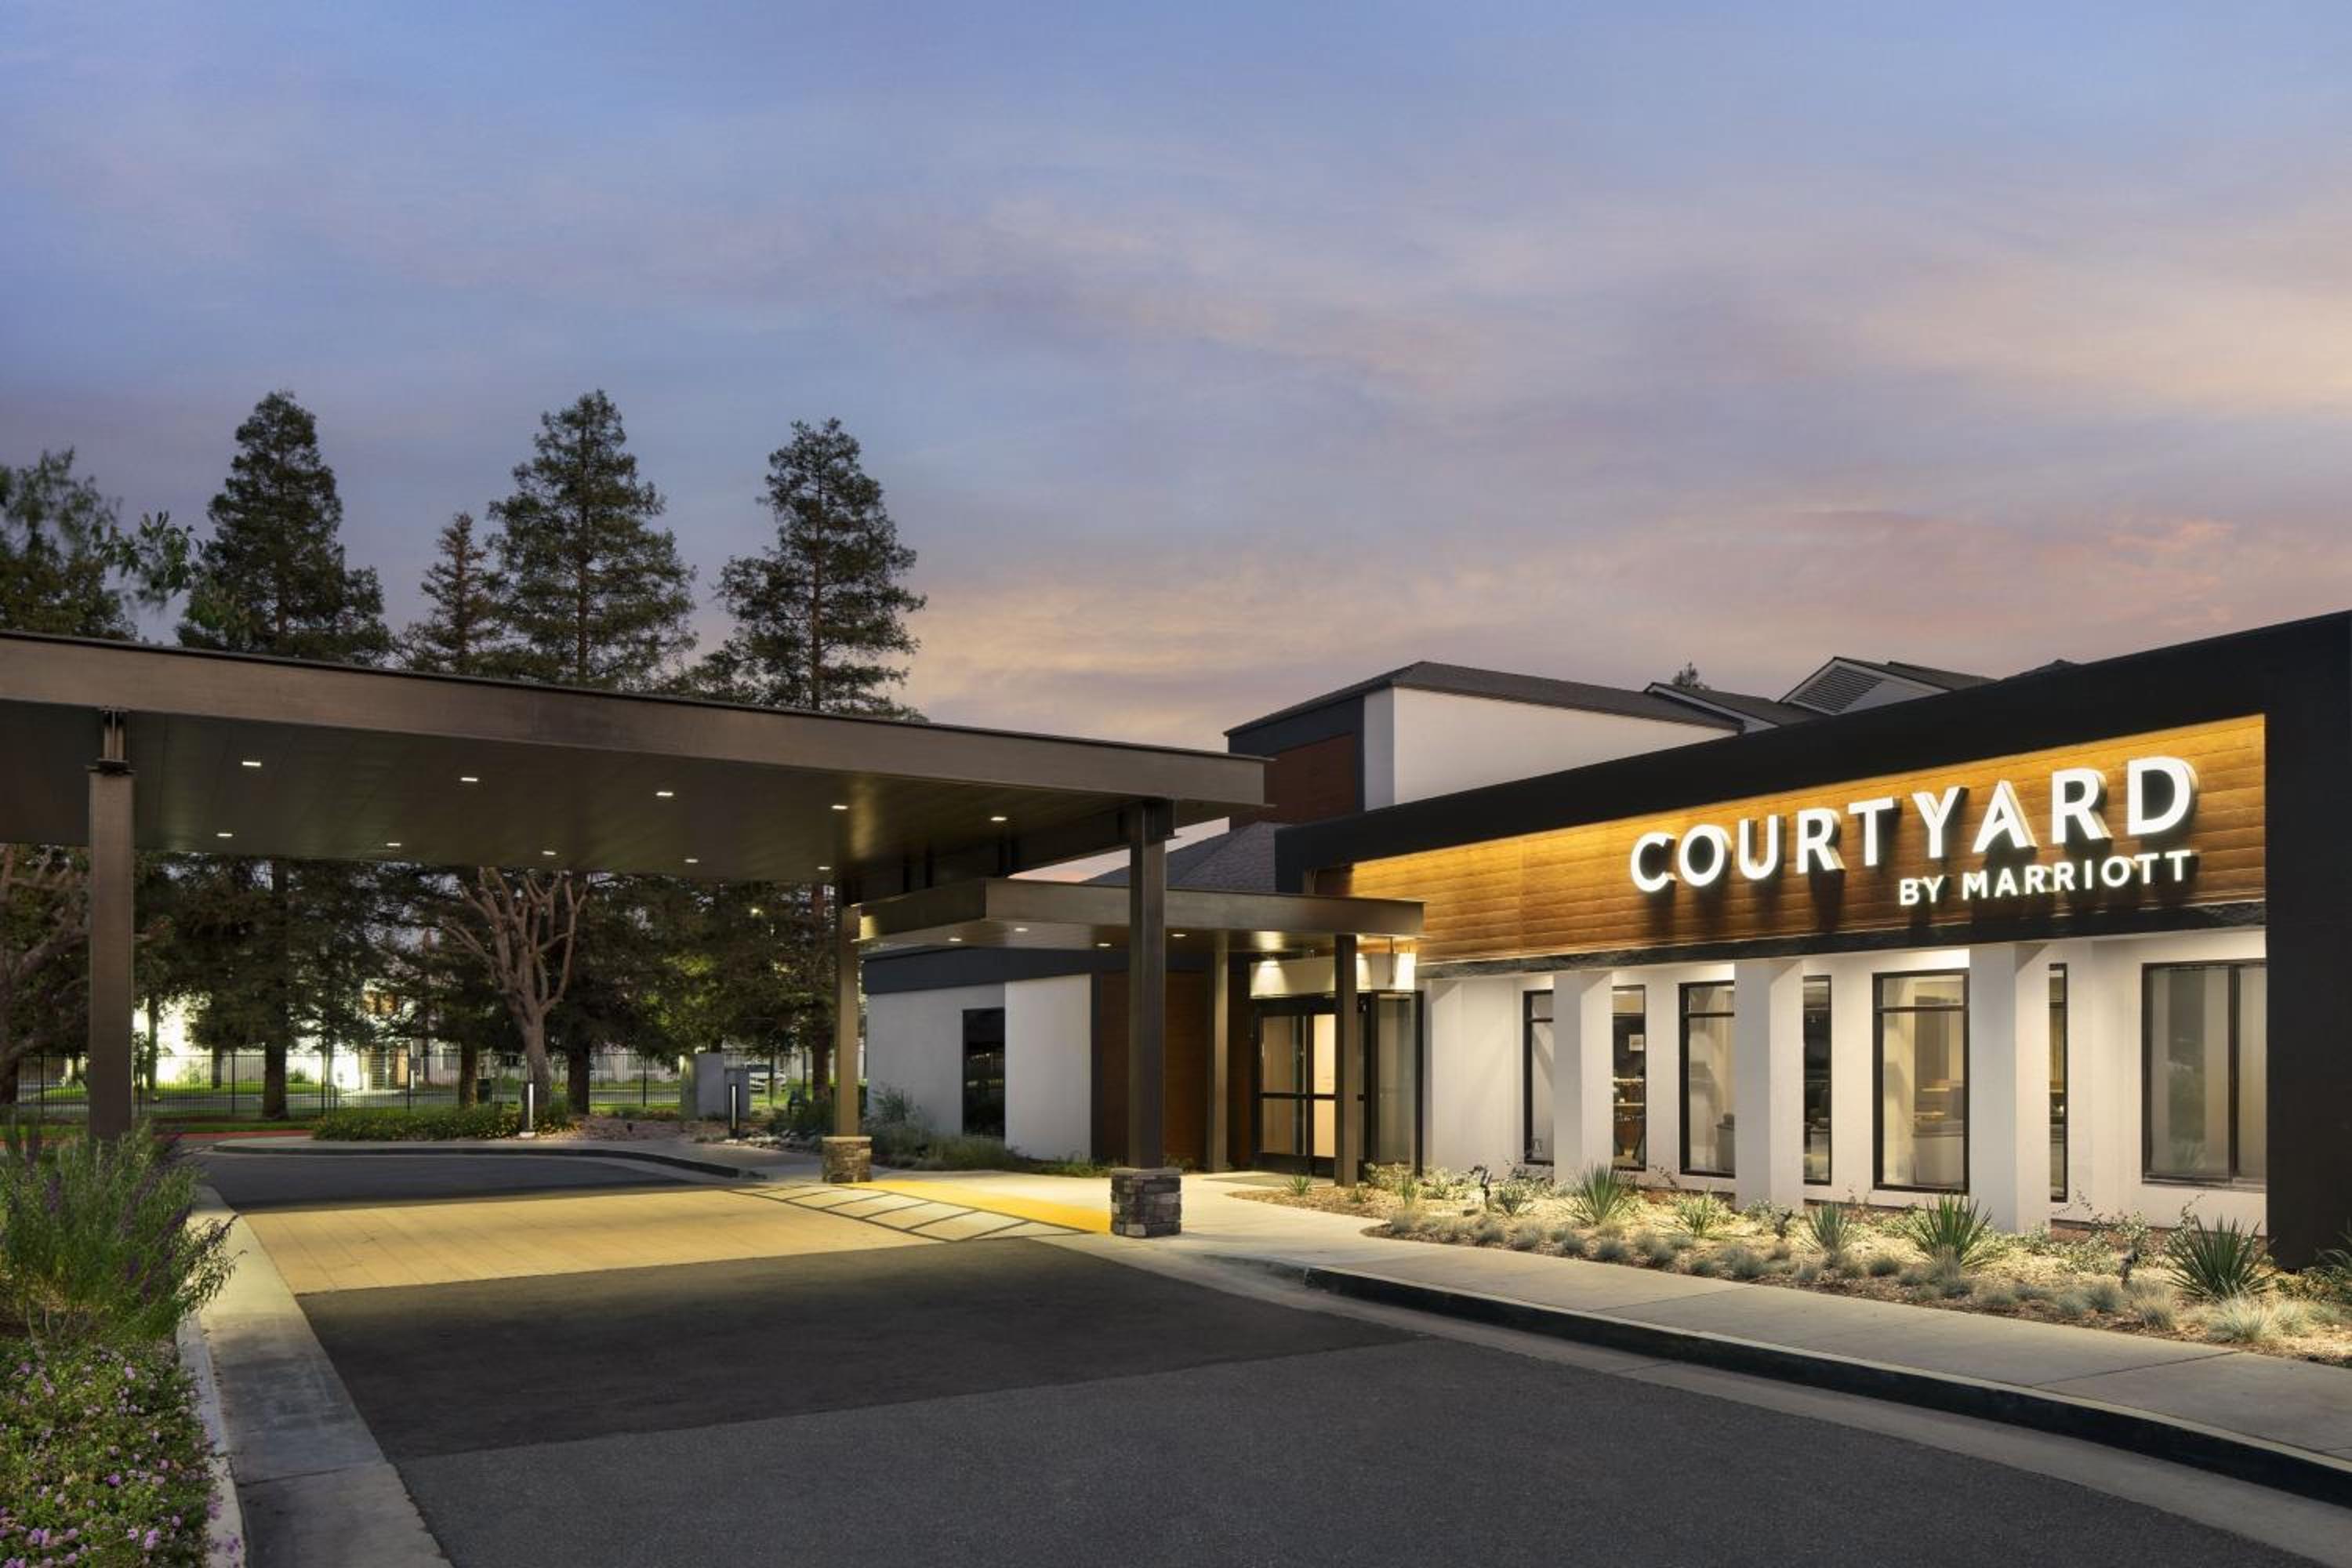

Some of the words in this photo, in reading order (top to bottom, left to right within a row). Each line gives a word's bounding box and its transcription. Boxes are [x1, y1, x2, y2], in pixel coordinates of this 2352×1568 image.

[1629, 756, 2198, 893] COURTYARD
[1898, 877, 1944, 906] BY
[1962, 850, 2192, 900] MARRIOTT
